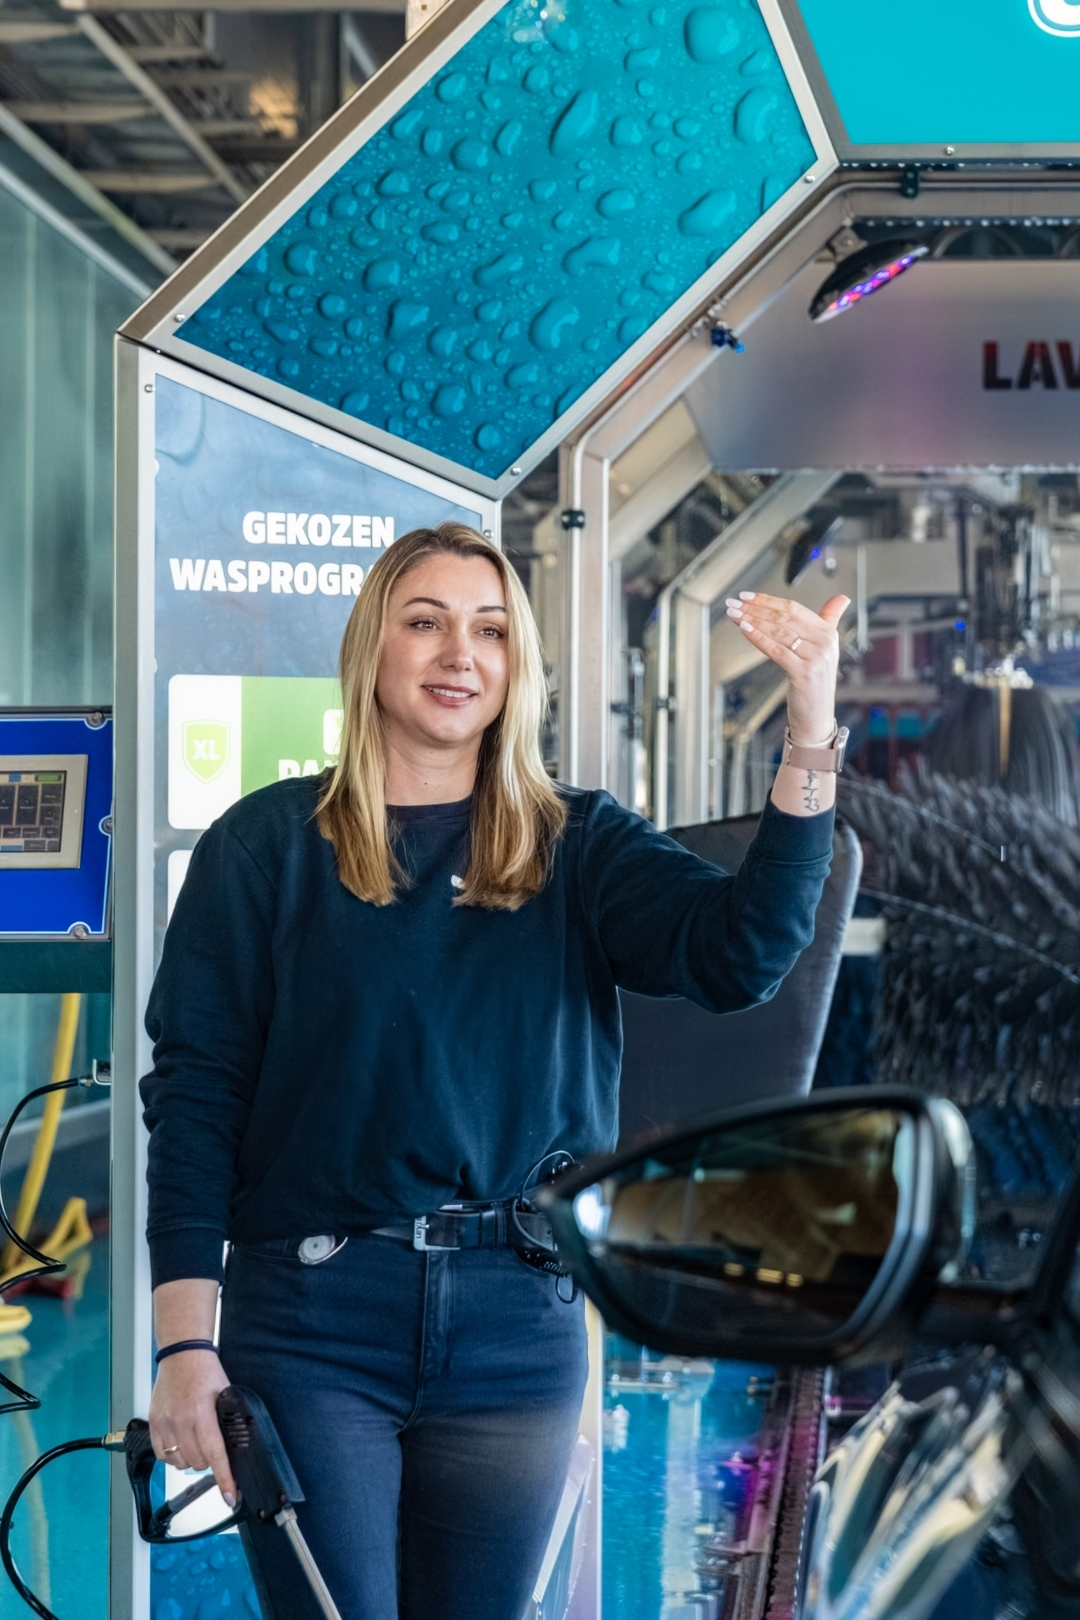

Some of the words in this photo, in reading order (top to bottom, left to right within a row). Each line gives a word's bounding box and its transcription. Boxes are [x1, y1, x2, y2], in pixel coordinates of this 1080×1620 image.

[242, 511, 394, 548] GEKOZEN
[169, 558, 374, 596] WASPROGR
[193, 738, 221, 760] XL
